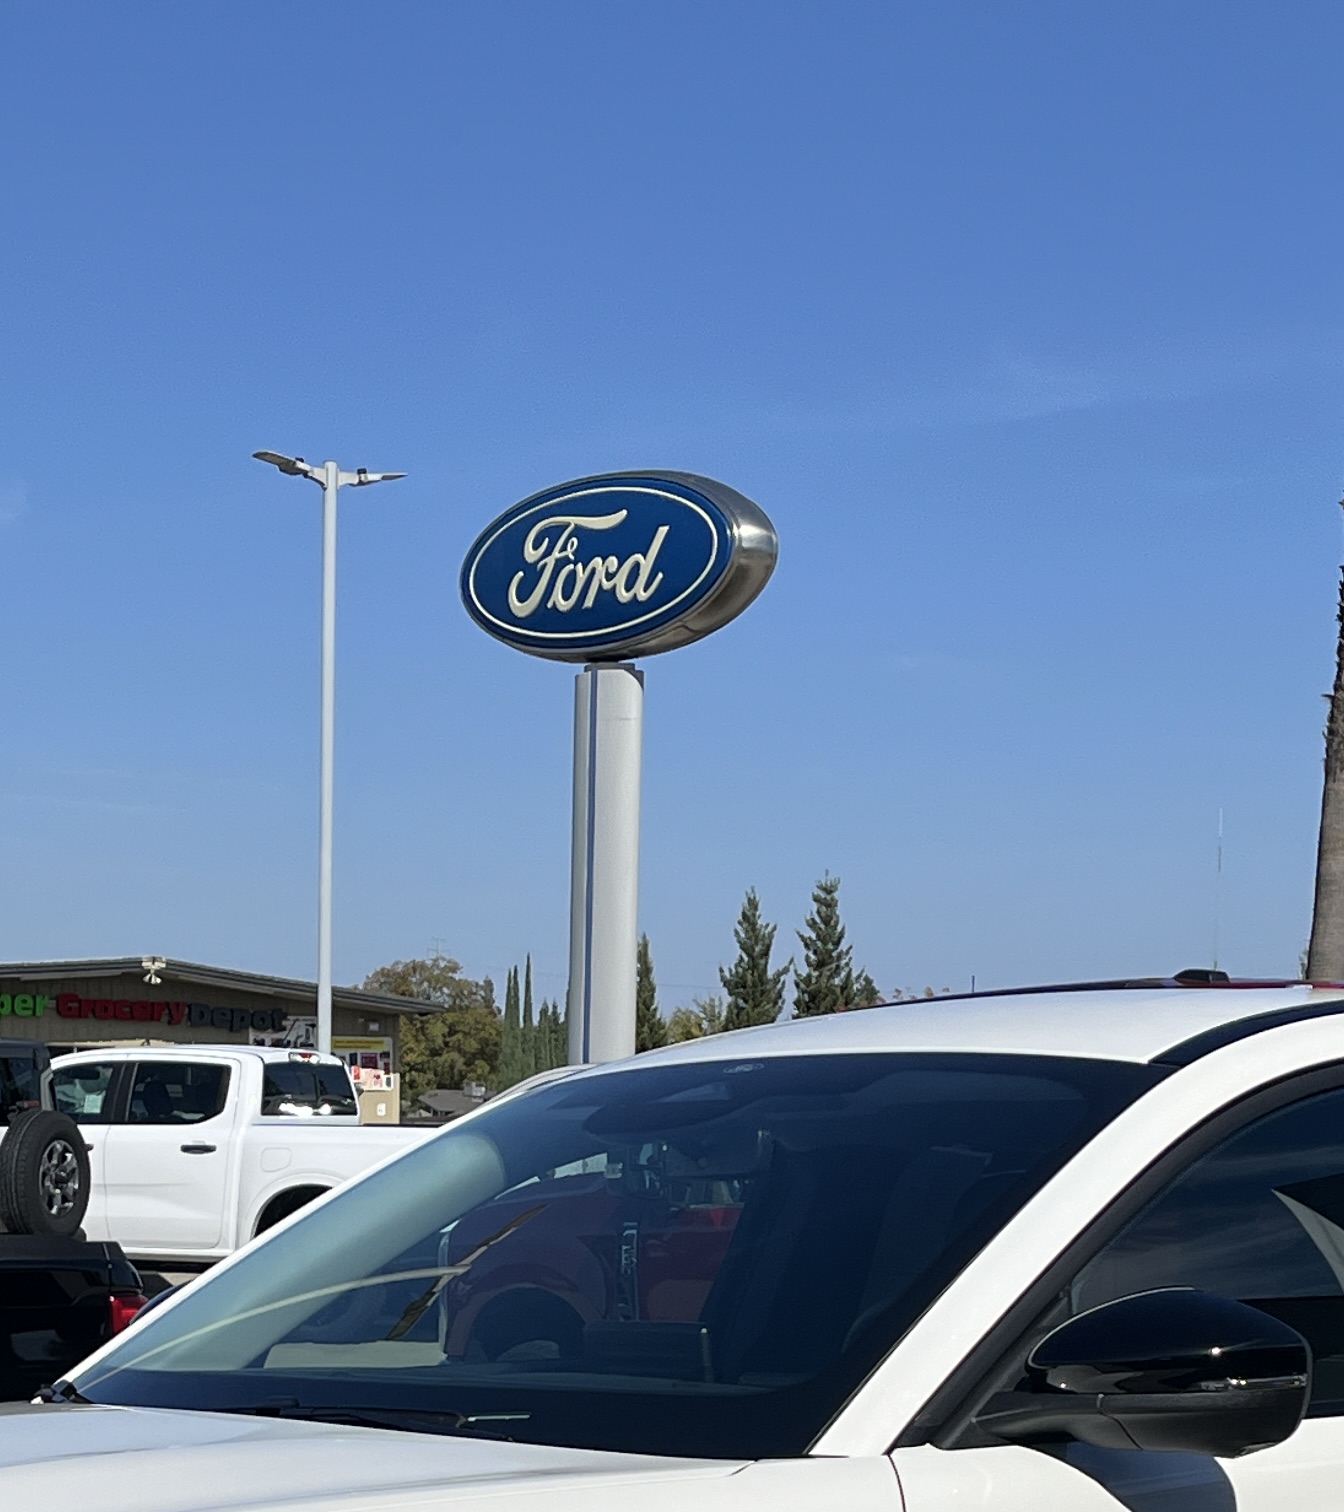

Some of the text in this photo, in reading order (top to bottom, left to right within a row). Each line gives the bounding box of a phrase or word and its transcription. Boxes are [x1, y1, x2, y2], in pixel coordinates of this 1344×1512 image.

[508, 509, 670, 618] Ford
[58, 993, 187, 1025] Grocery
[188, 1003, 287, 1032] Depot
